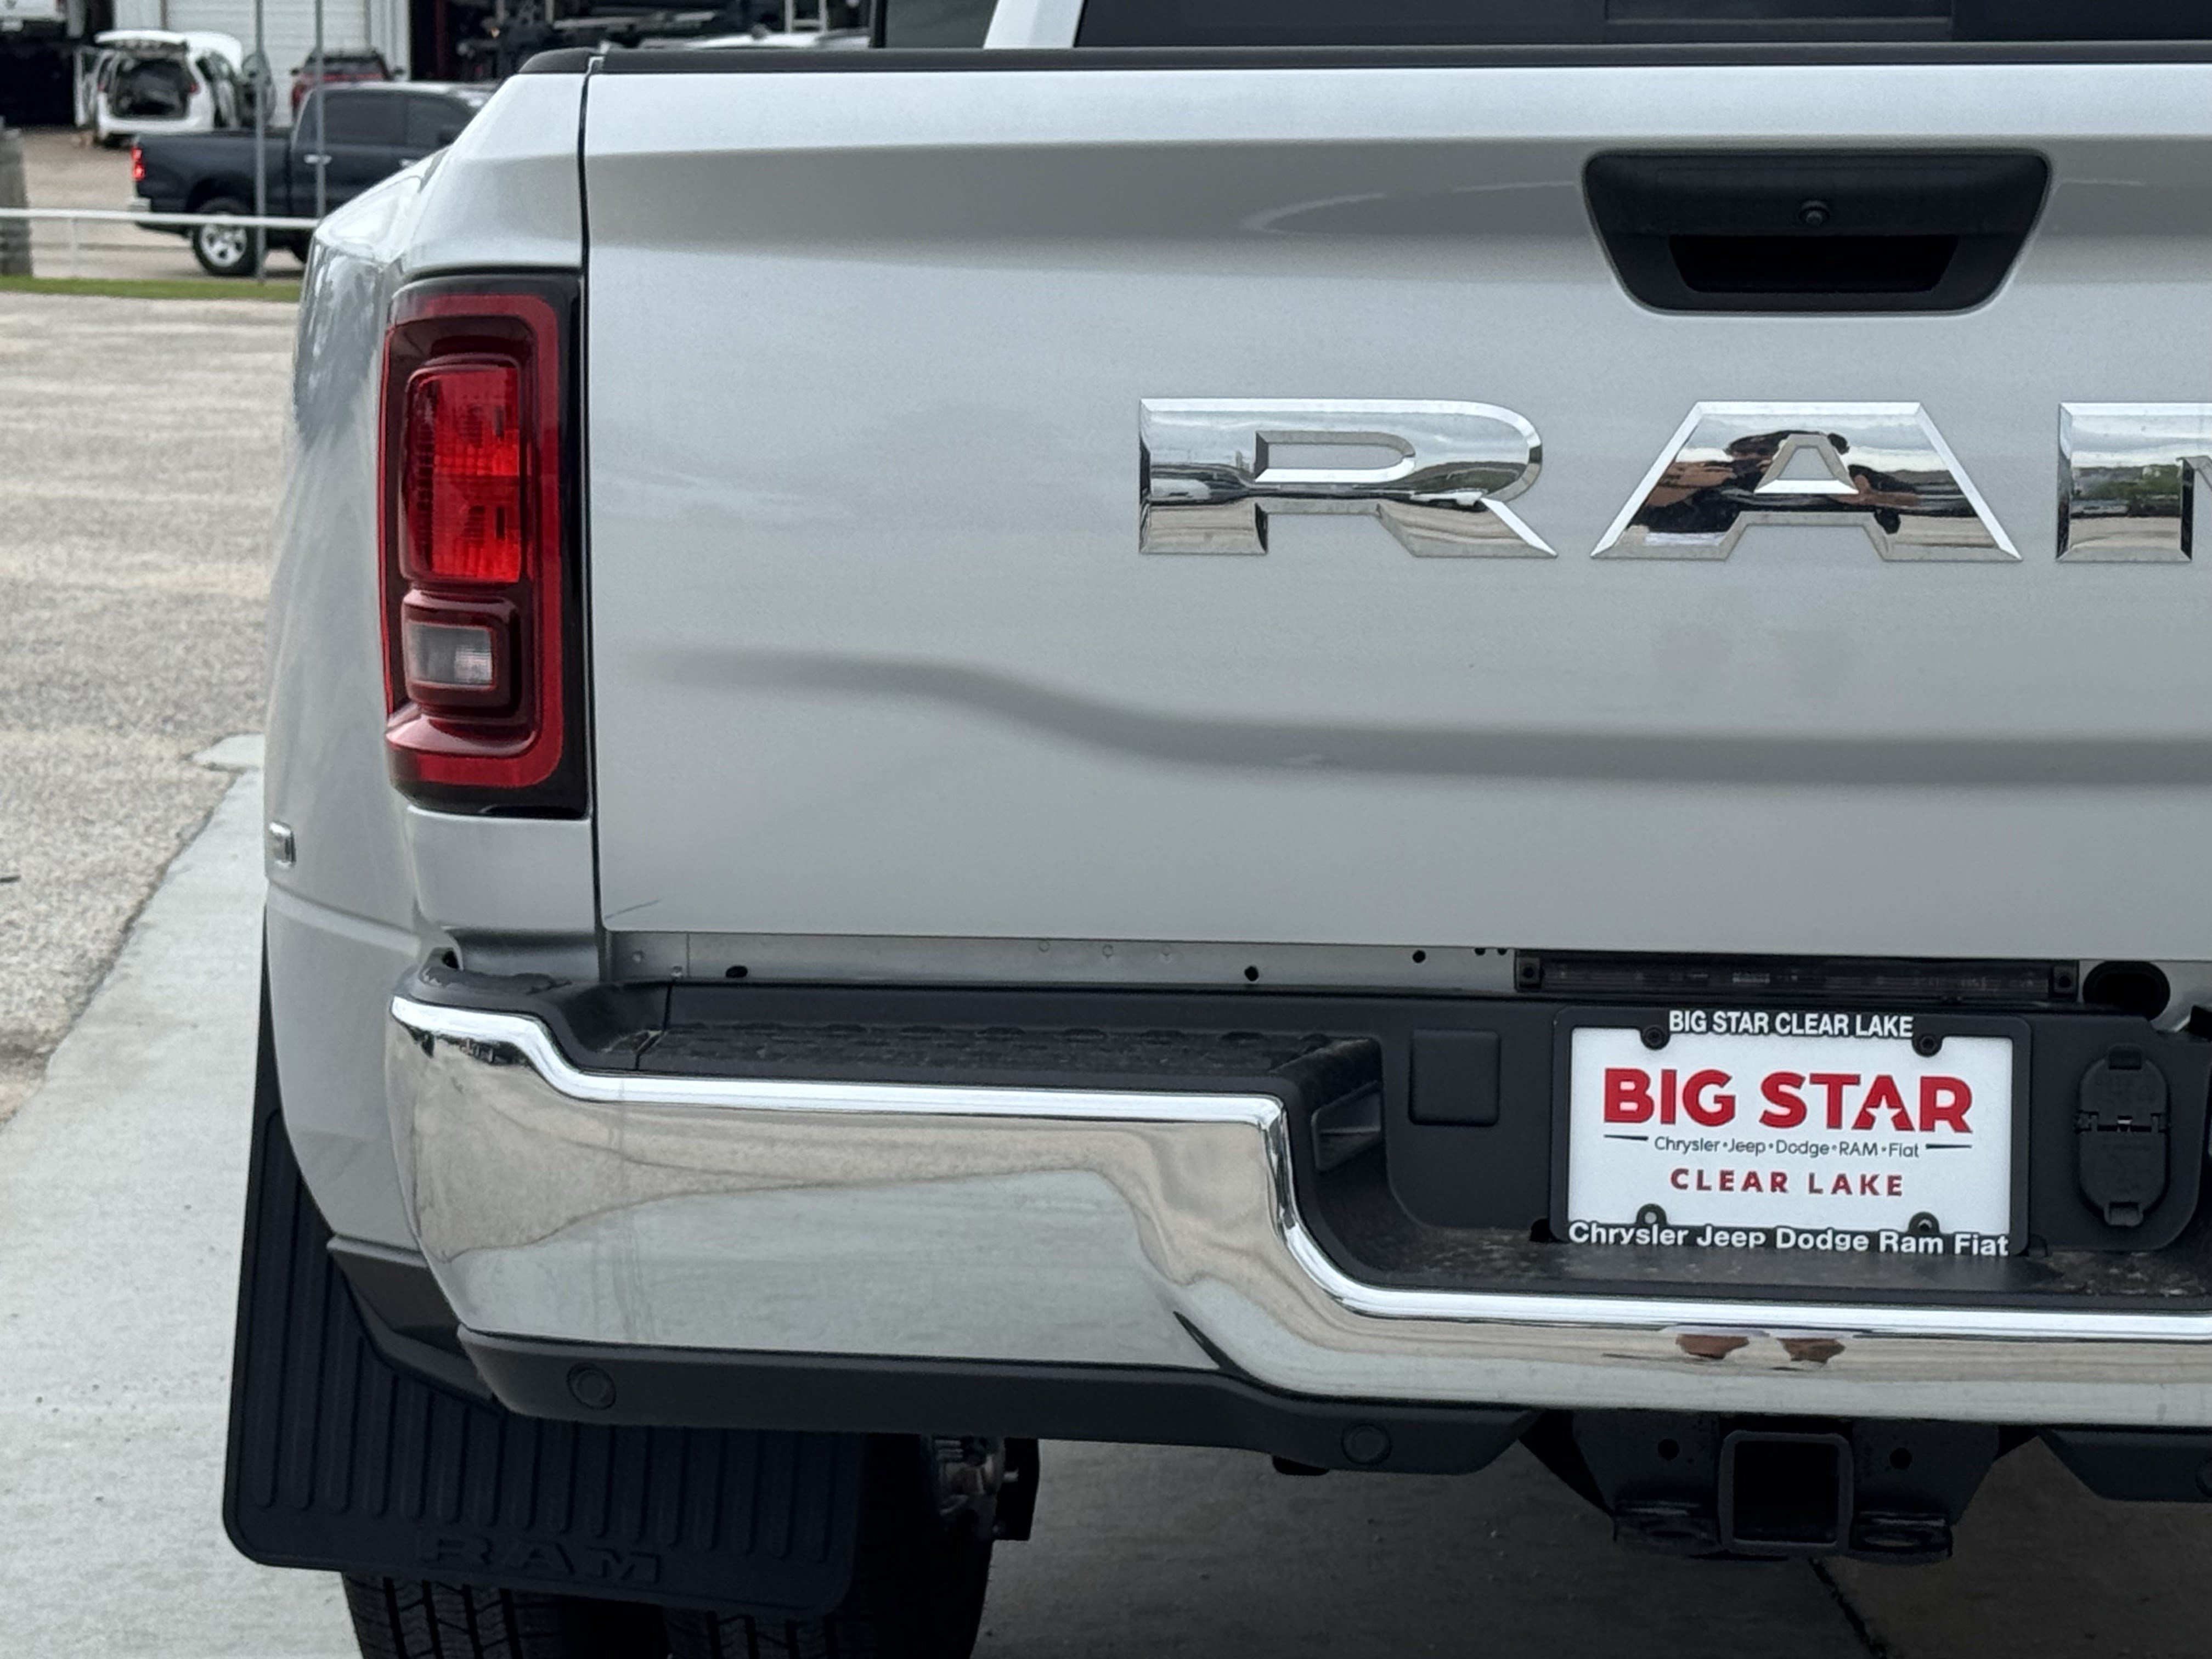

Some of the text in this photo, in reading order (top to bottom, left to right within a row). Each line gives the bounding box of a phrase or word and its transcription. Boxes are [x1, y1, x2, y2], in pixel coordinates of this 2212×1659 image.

[1668, 1011, 1914, 1038] BIG STAR CLEAR LAKE
[1604, 1067, 1973, 1133] BIG STAR
[1654, 1136, 1920, 1159] Chrysler Jeep Dodge RAM Fiat
[1671, 1167, 1903, 1197] CLEAR LAKE
[1568, 1221, 2010, 1257] Chrysler Jeep Dodge Ram Fiat
[416, 1533, 662, 1584] RAM
